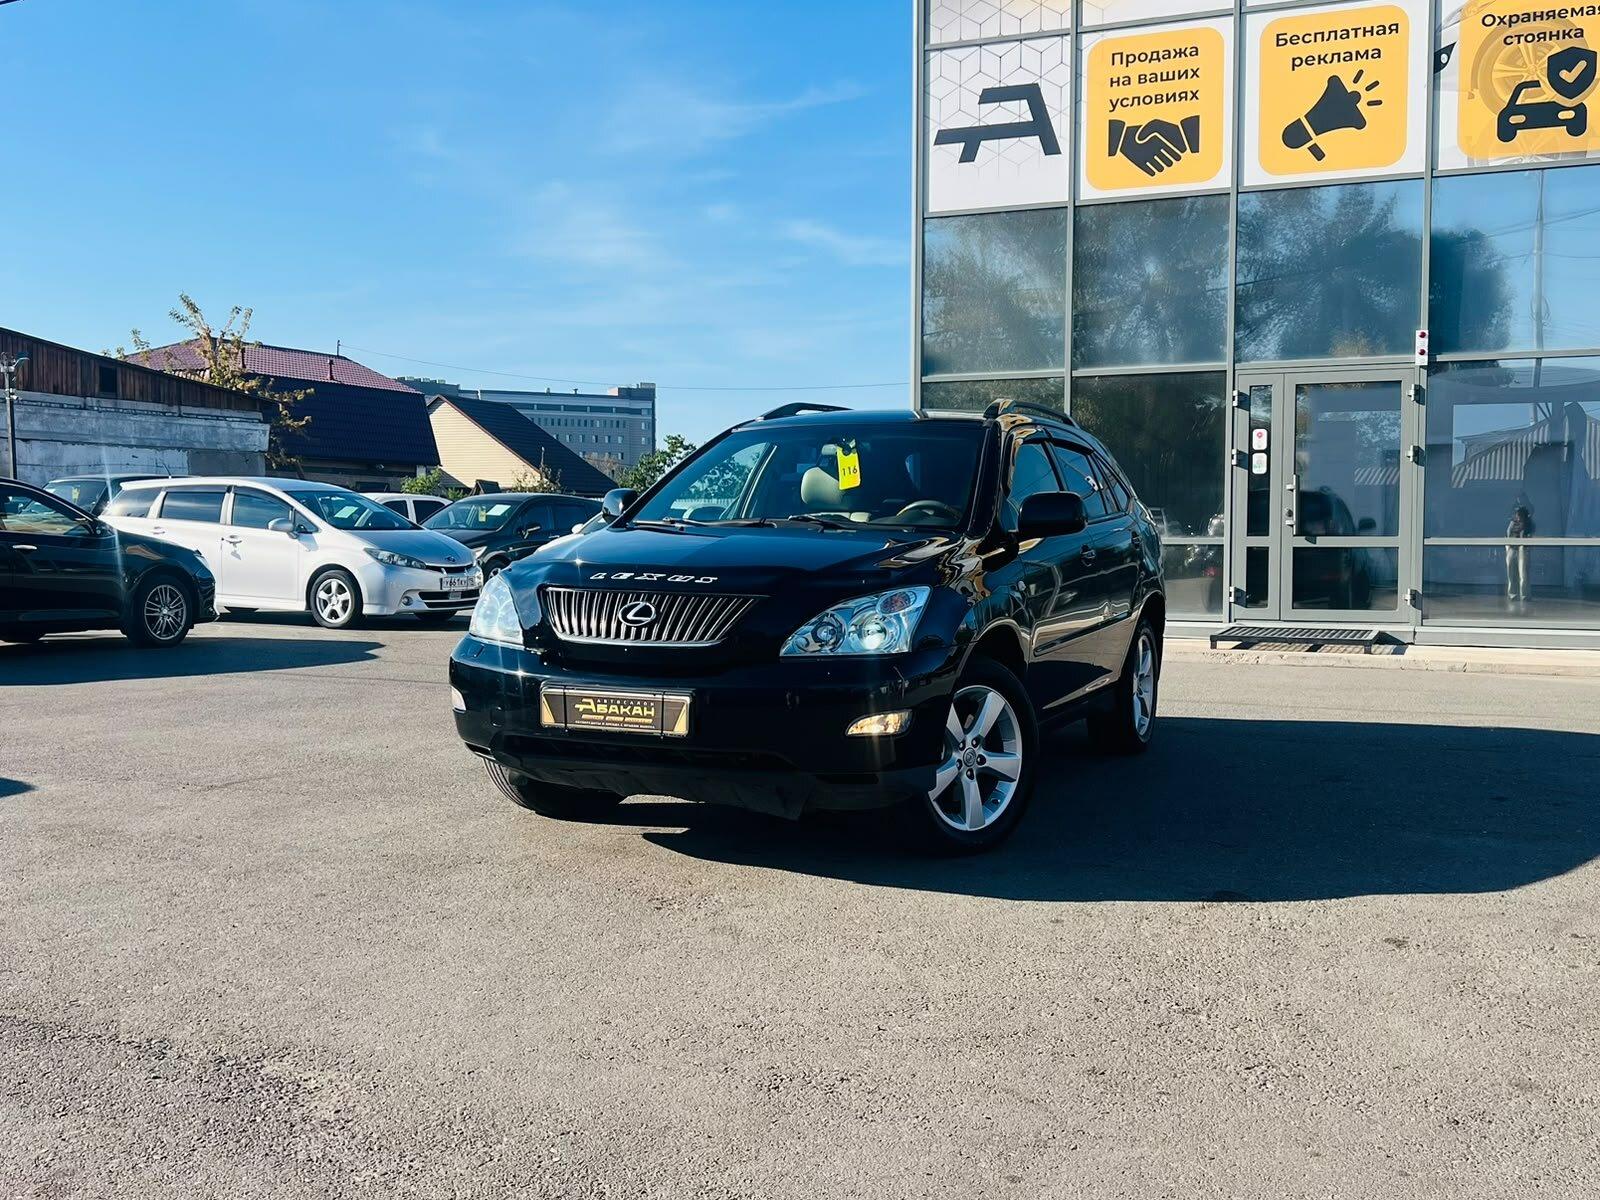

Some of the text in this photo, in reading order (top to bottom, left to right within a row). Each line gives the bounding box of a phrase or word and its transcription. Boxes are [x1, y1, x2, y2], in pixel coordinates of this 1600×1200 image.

[1481, 5, 1600, 28] Охраняема
[1275, 22, 1399, 47] Бесплатная
[1503, 27, 1584, 46] стоянка
[1111, 45, 1199, 68] Продажа
[1291, 47, 1381, 71] реклама
[1109, 67, 1200, 88] на ваших
[1108, 89, 1200, 113] условиях
[842, 465, 858, 476] 116
